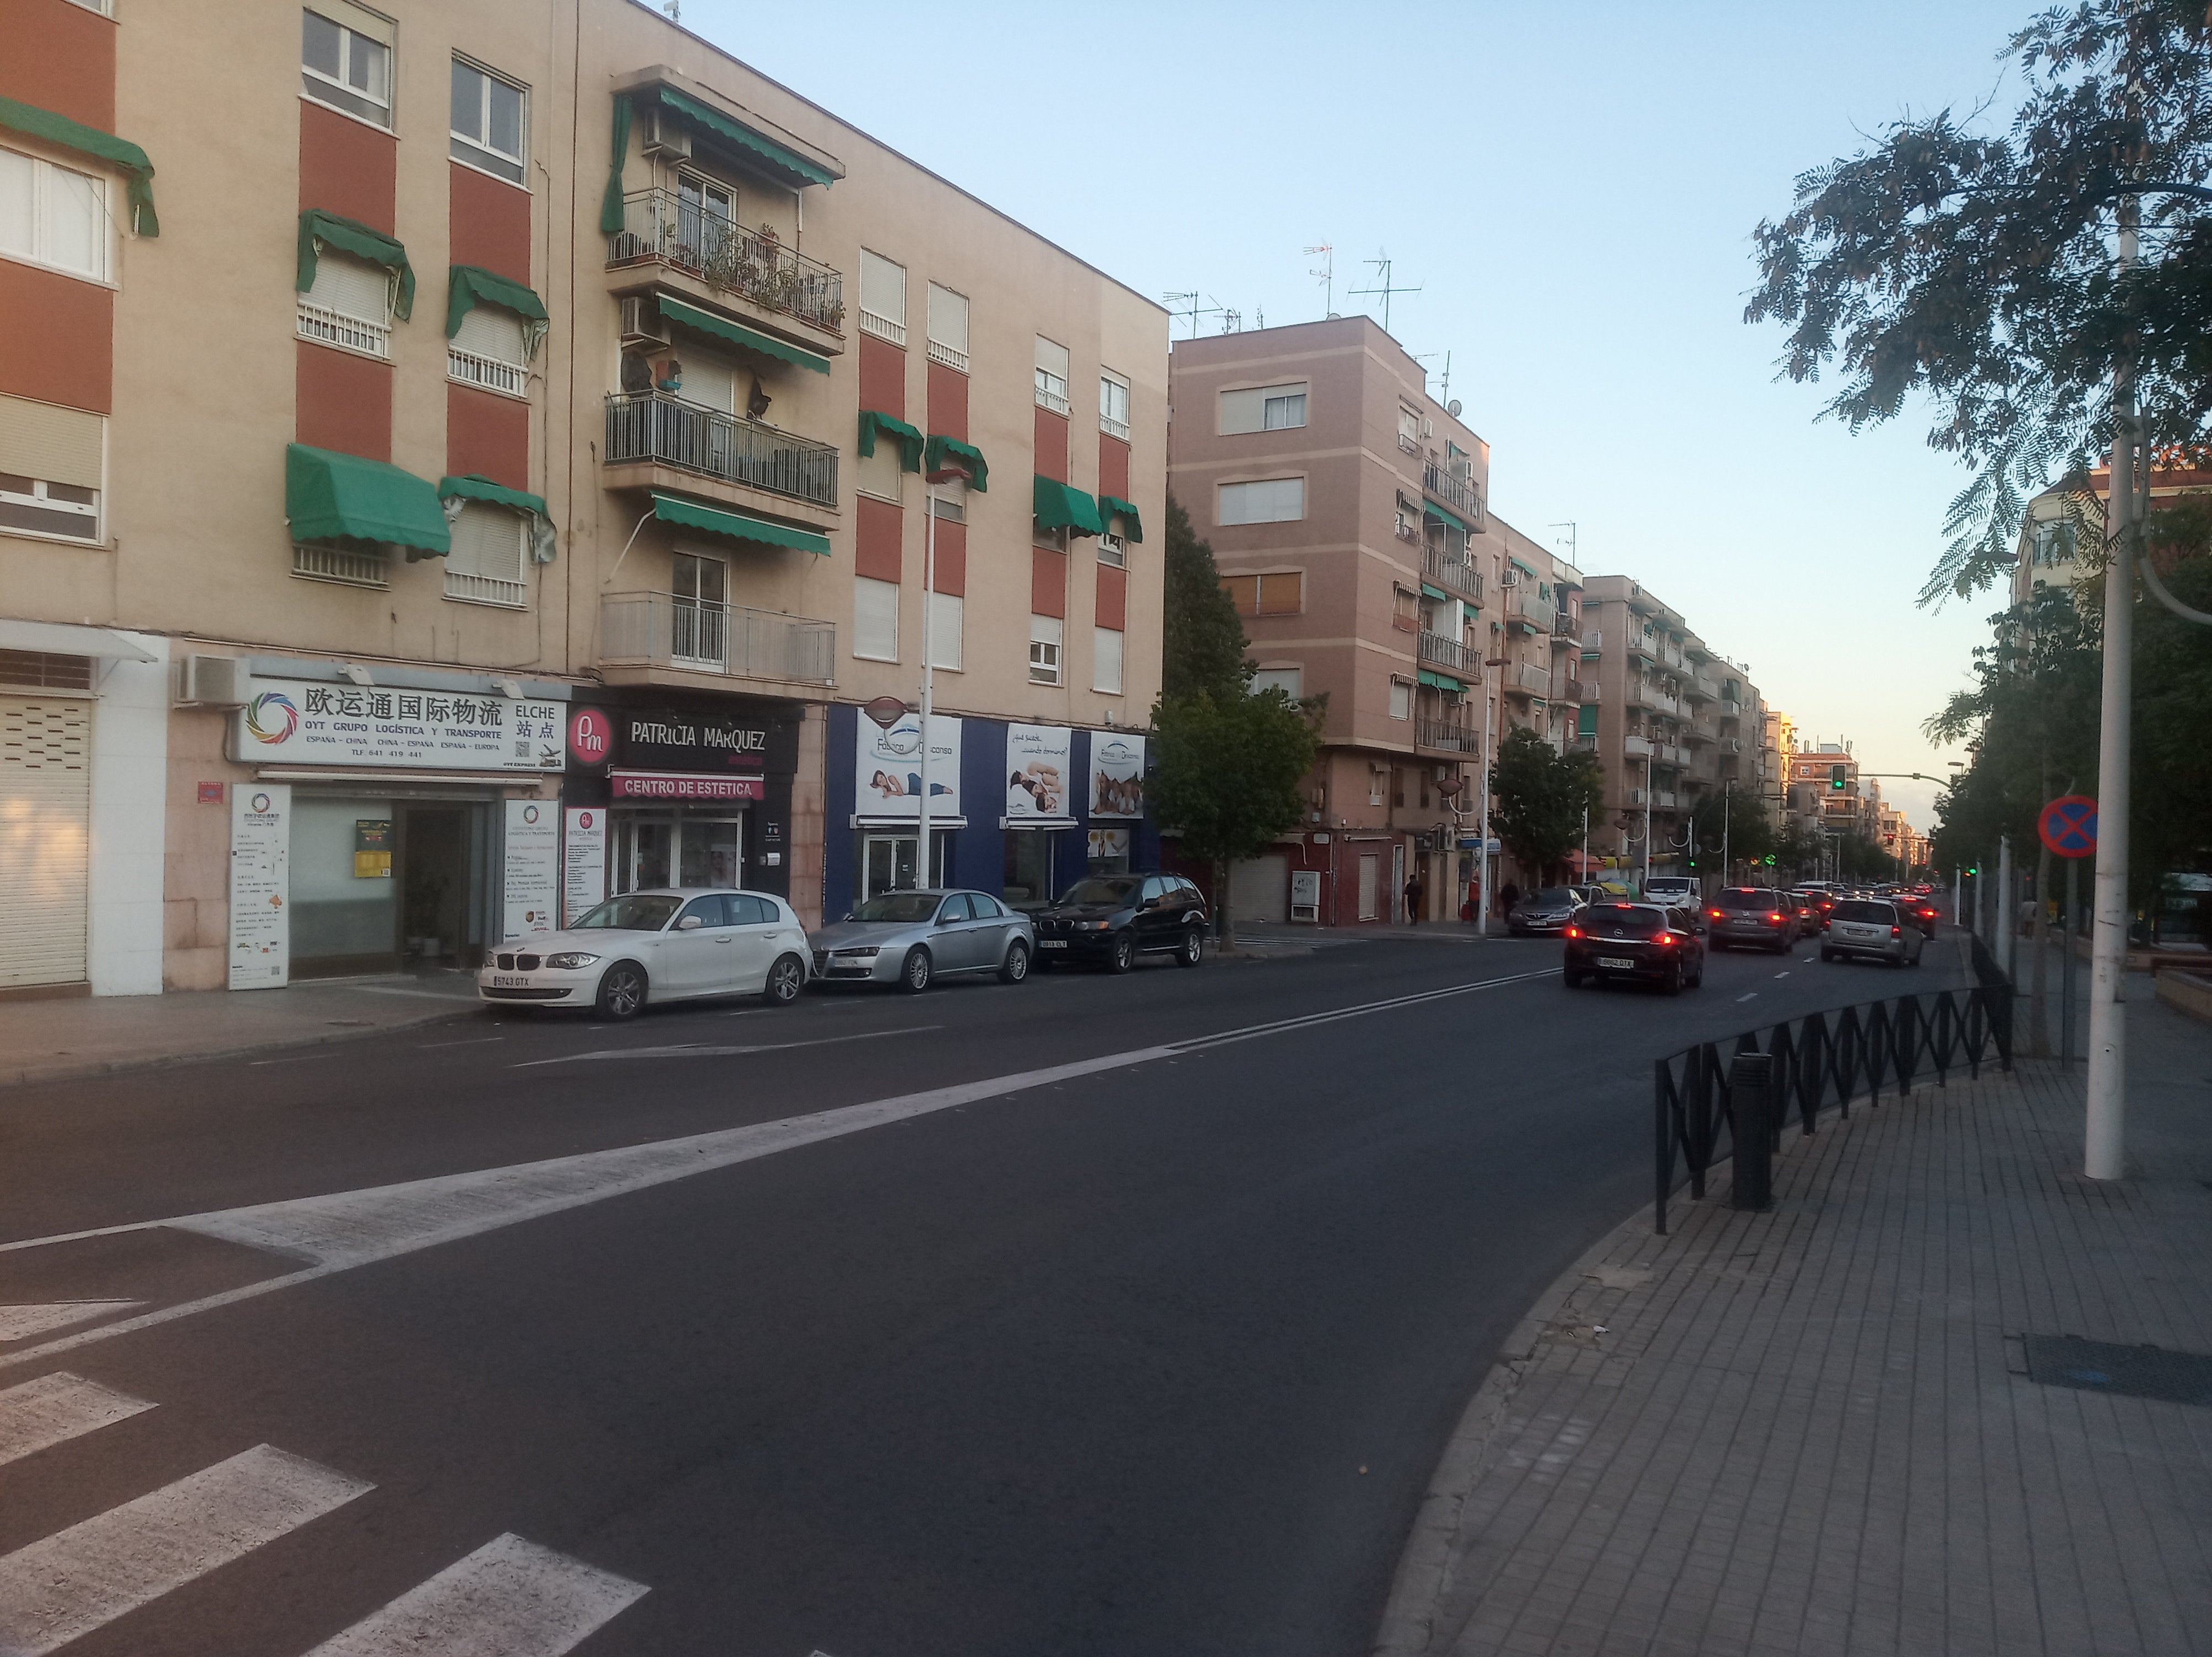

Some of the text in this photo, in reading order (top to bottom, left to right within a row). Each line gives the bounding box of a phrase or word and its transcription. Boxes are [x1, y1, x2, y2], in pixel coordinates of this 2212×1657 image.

[305, 688, 502, 725] 欧运通国际物流
[516, 705, 555, 719] ELCHE
[305, 721, 325, 729] OYT
[334, 722, 367, 732] GRUPO
[376, 724, 424, 734] LOGÍSTICA
[445, 729, 501, 739] TRANSPORTE
[517, 721, 554, 739] 站点
[631, 721, 766, 753] PATRICIA MARQUEZ
[625, 779, 752, 795] CENTRO DE ESTETICA
[497, 977, 529, 986] 5743 GTX
